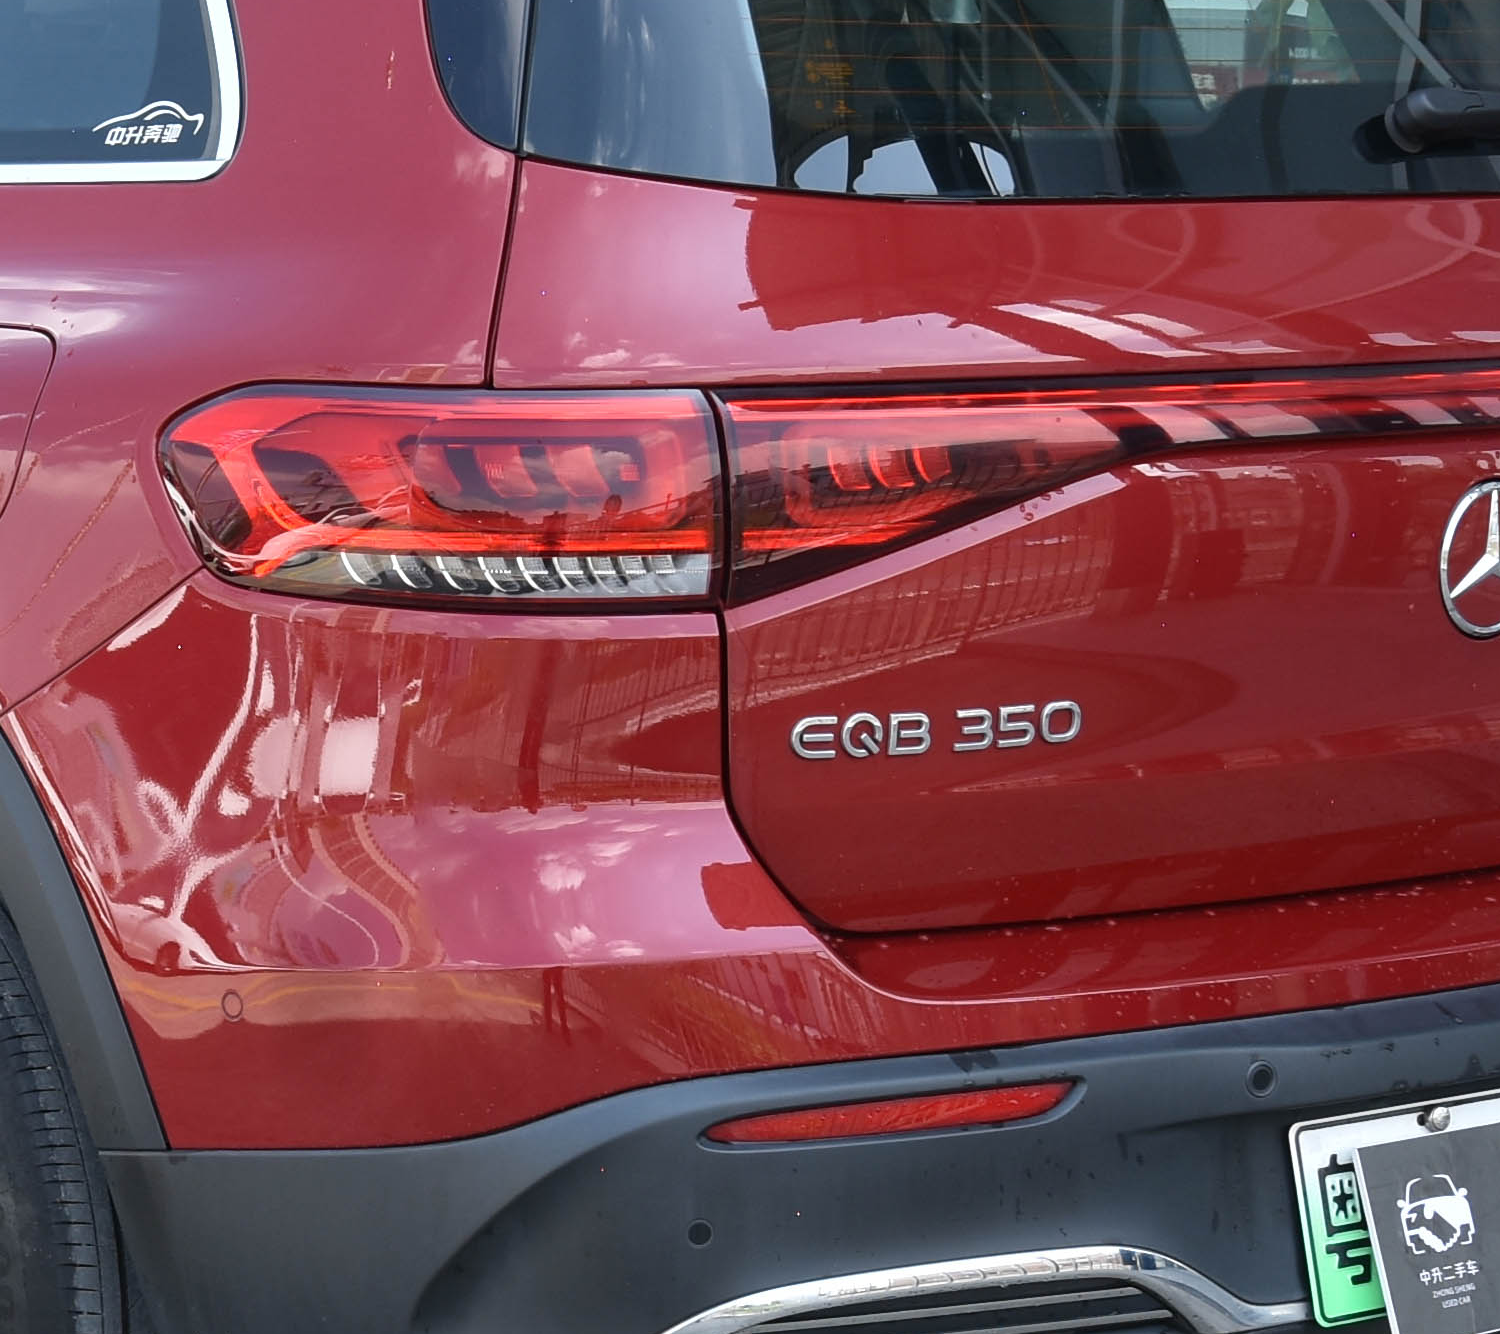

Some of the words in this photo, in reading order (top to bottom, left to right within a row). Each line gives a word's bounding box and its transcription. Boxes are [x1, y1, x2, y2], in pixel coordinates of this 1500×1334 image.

[790, 711, 934, 760] EQB
[953, 699, 1084, 754] 350
[1419, 1259, 1480, 1286] 中升二手车
